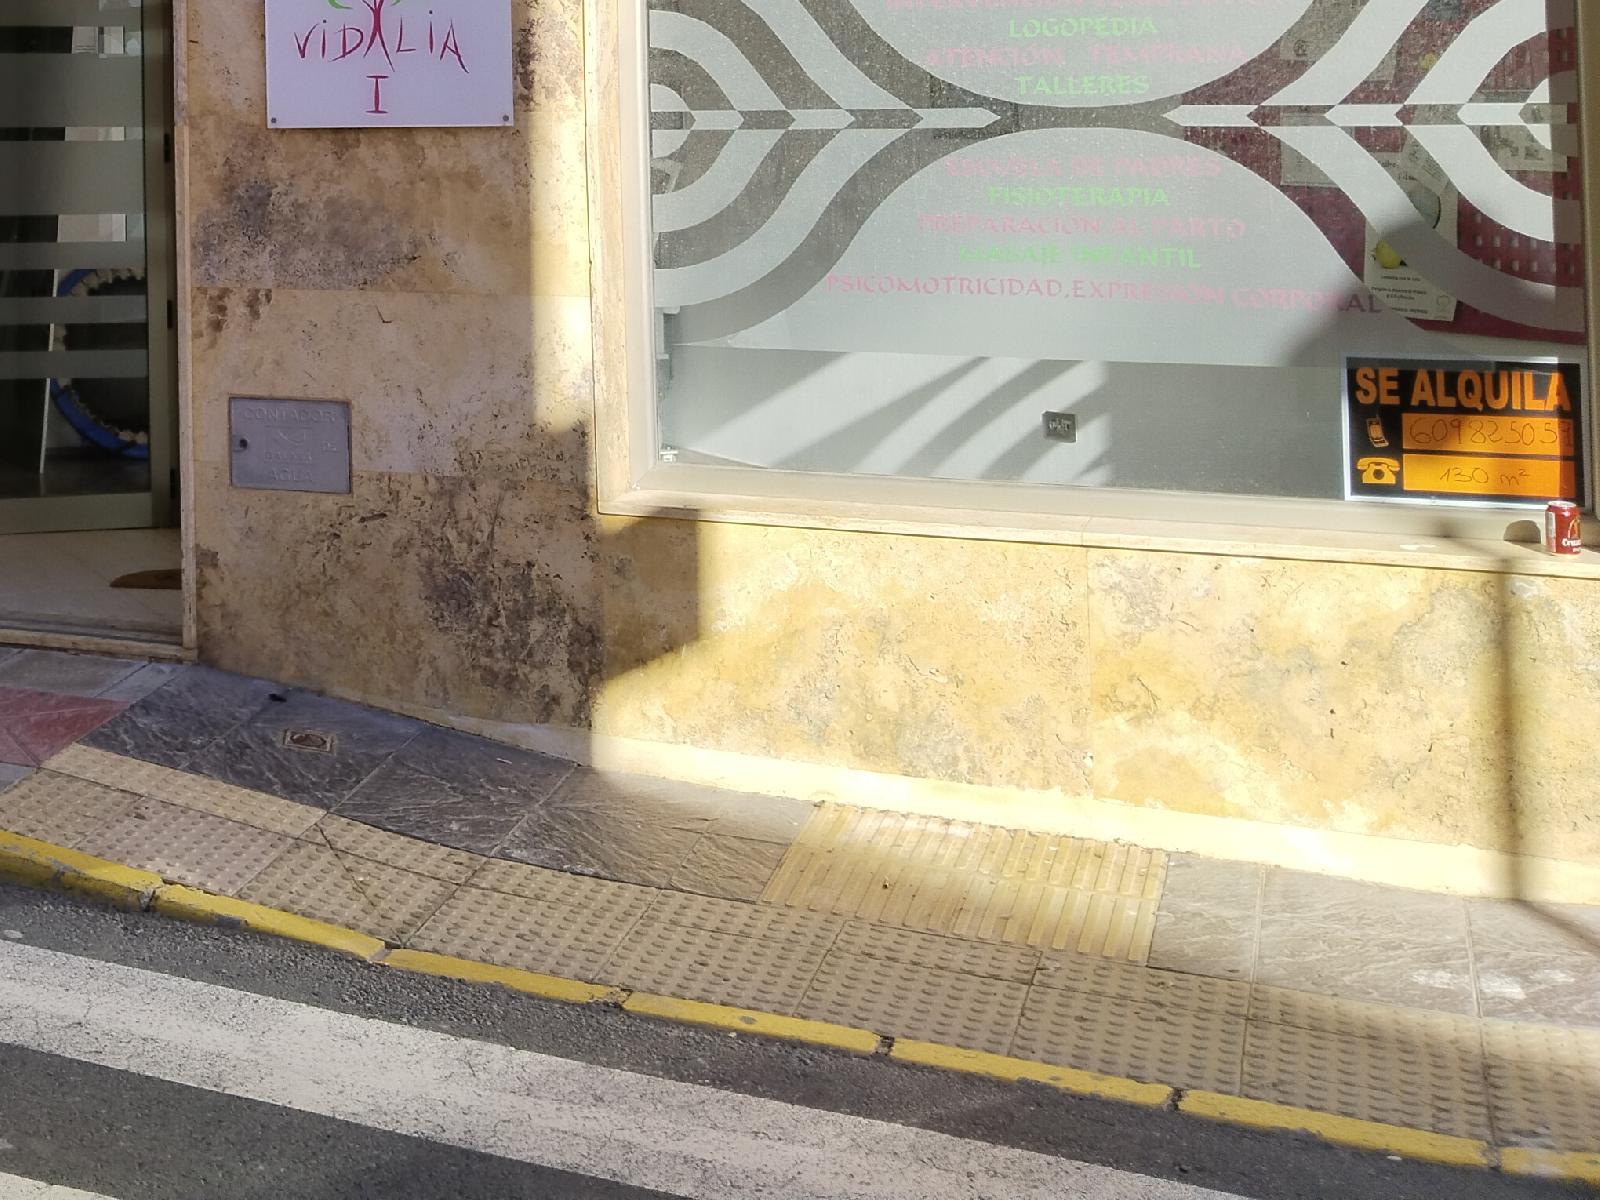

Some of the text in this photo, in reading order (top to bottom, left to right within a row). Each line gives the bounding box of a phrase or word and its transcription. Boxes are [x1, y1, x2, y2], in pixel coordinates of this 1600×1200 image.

[1008, 16, 1158, 38] LOGOPEDIA
[1016, 73, 1150, 95] TALLERES
[987, 185, 1169, 206] FISIOTERAPIA
[1153, 216, 1246, 239] PARTO
[960, 246, 1202, 268] MASAJE INFANTIL
[1231, 287, 1382, 314] CORPORAL
[1355, 367, 1572, 412] SE ALQUILA
[1439, 466, 1490, 484] 130
